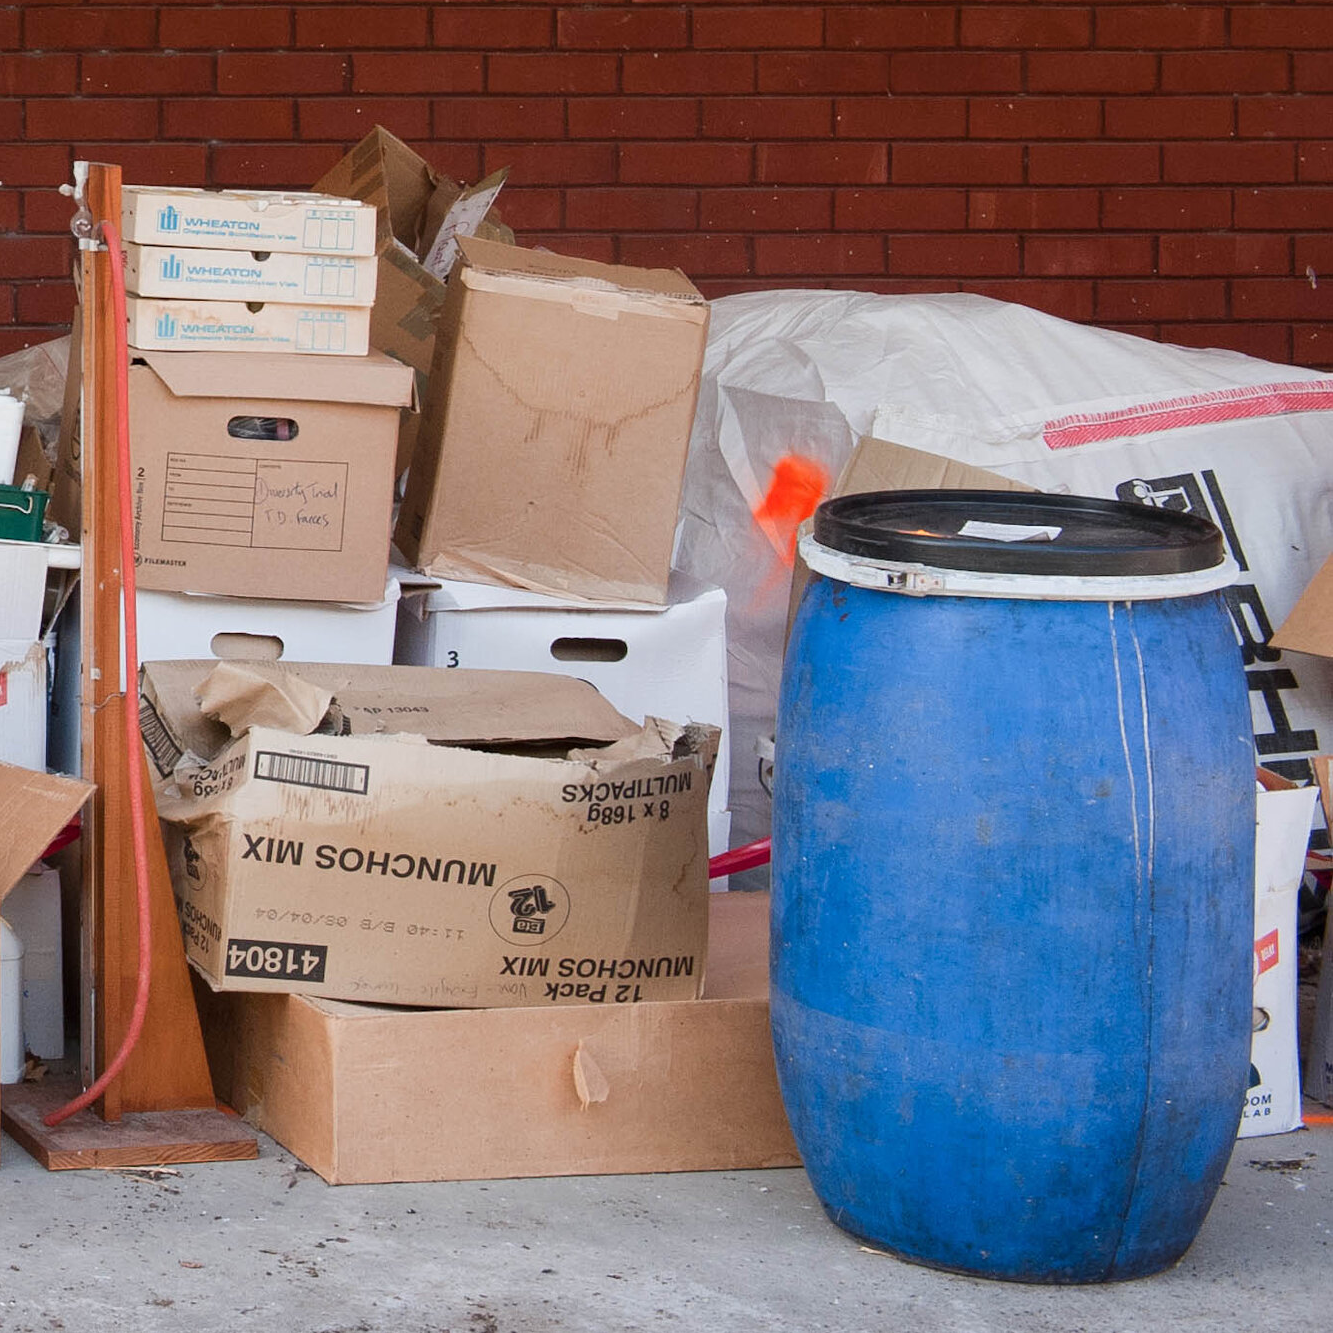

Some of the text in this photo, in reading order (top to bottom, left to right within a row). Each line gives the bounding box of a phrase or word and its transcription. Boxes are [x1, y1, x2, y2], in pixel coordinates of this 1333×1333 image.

[184, 217, 260, 231] WHEATON
[186, 266, 262, 278] WHEATON
[180, 323, 254, 334] WHEATON
[144, 558, 187, 567] FILEMASTER
[446, 649, 459, 669] 3
[561, 771, 692, 802] MULTIPACKS
[587, 800, 670, 825] 8 x 168g
[242, 833, 497, 887] MUNCHOS MIX
[407, 923, 465, 941] 11:40
[516, 920, 542, 933] Eta
[228, 944, 320, 976] 41804
[500, 955, 694, 980] MUNCHOS MIX
[544, 982, 643, 1003] 12 Pack
[1243, 1107, 1272, 1119] LAB
